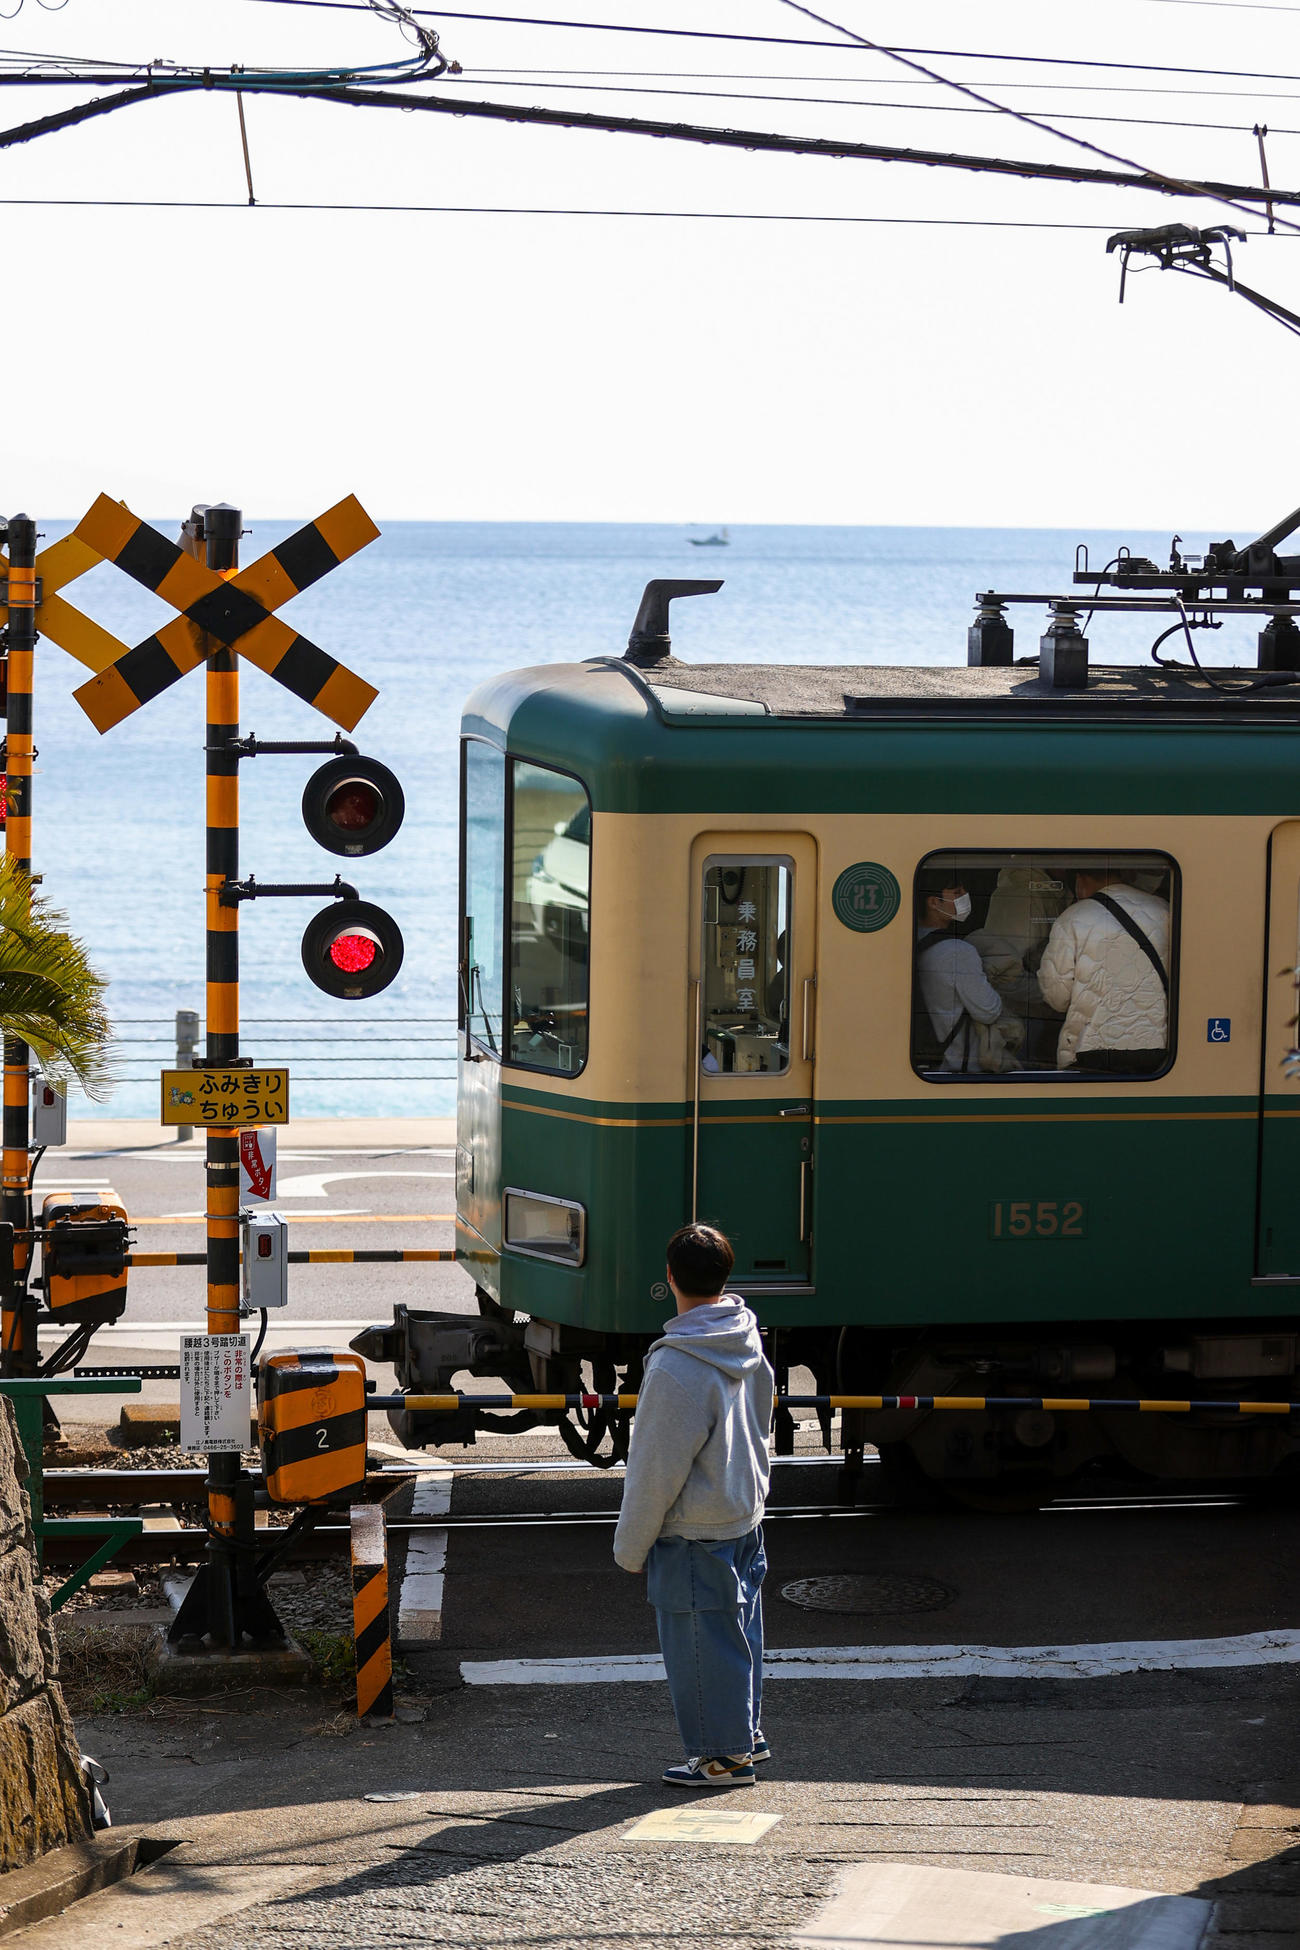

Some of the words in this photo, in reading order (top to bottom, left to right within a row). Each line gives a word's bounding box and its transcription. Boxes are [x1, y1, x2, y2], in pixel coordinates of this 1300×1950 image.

[736, 901, 758, 1012] 乗務員室
[199, 1074, 282, 1095] ふみきり
[199, 1100, 283, 1120] ちゅうい
[248, 1151, 268, 1194] 非常ボタン
[994, 1202, 1083, 1236] 1552
[223, 1350, 231, 1398] このボタンを
[316, 1428, 330, 1449] 2
